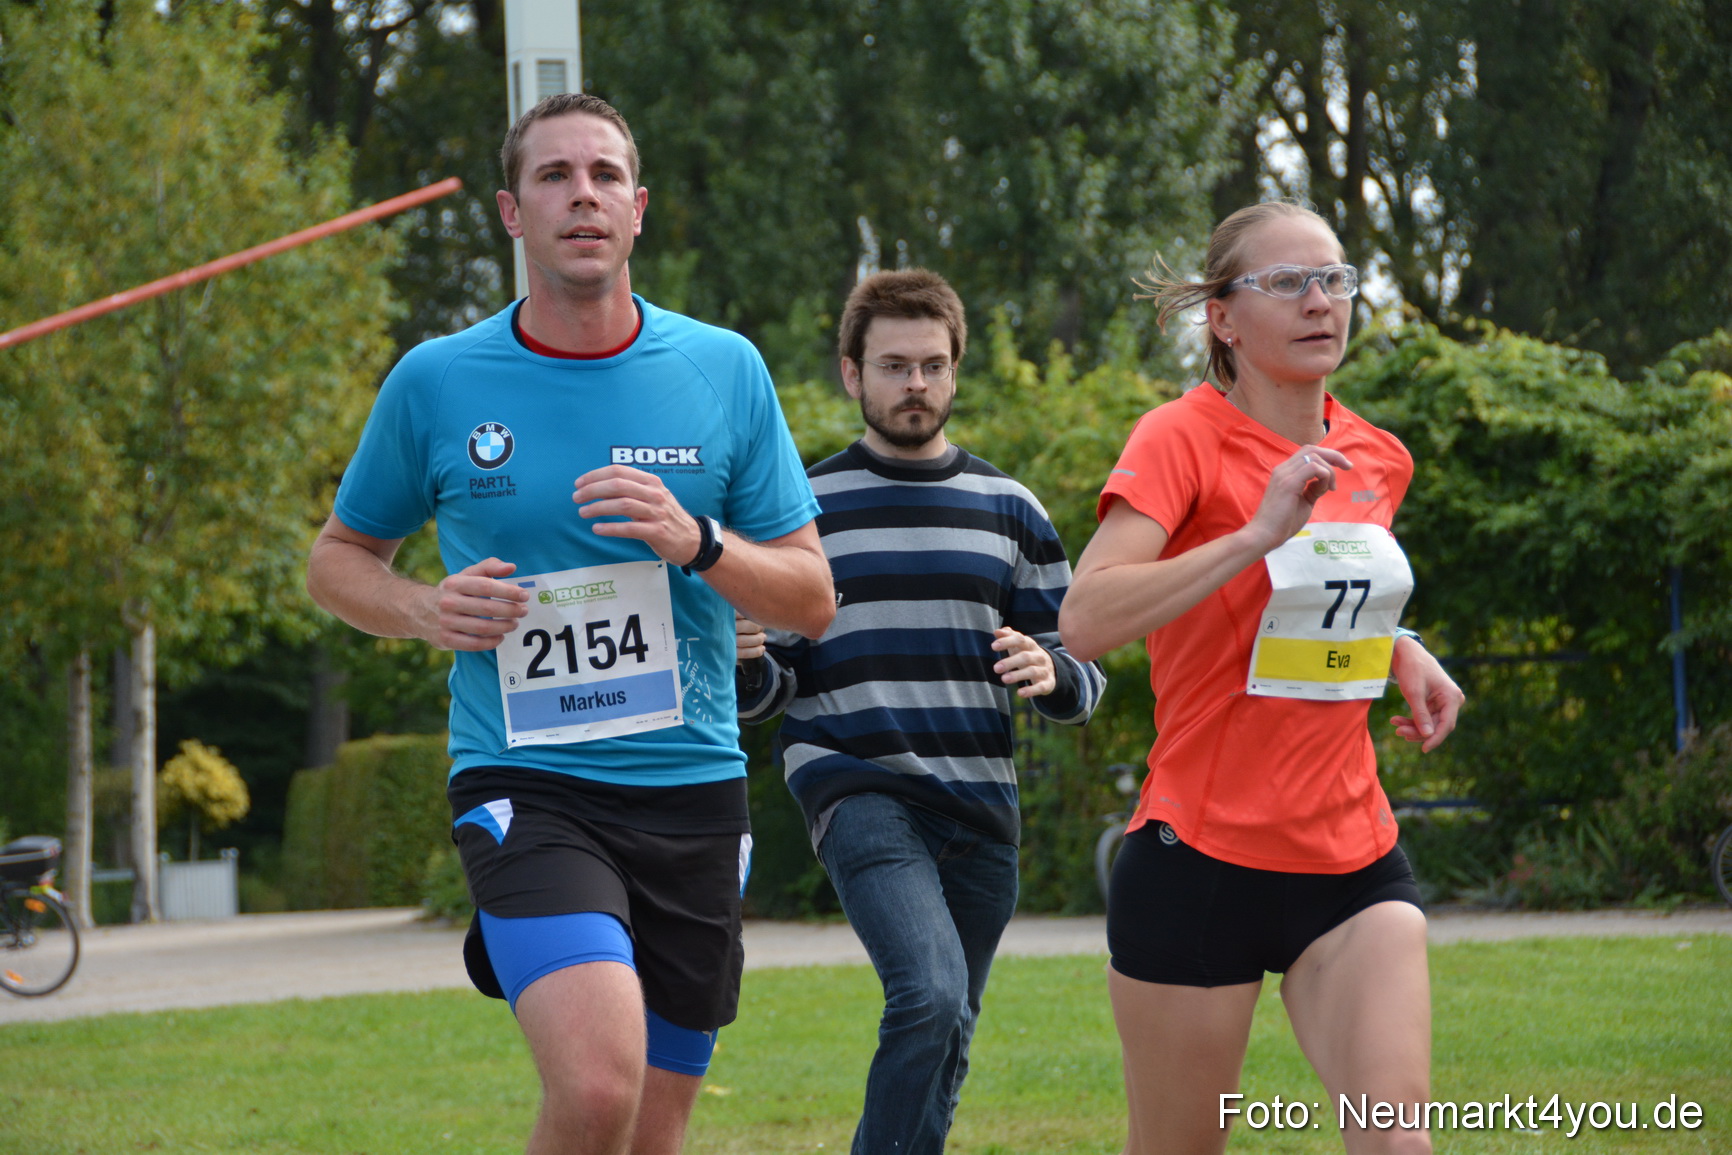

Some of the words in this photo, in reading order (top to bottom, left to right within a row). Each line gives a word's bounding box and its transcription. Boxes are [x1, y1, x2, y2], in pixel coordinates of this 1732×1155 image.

[611, 446, 703, 465] BOCK
[469, 476, 516, 490] PARTL
[470, 488, 517, 500] Neumarkt
[1328, 540, 1372, 554] BOCK
[555, 580, 616, 603] BOCK
[1321, 579, 1371, 629] 77
[1267, 620, 1274, 630] A
[523, 613, 648, 679] 2154
[1326, 650, 1351, 668] Eva
[509, 676, 516, 686] B
[559, 690, 627, 714] Markus
